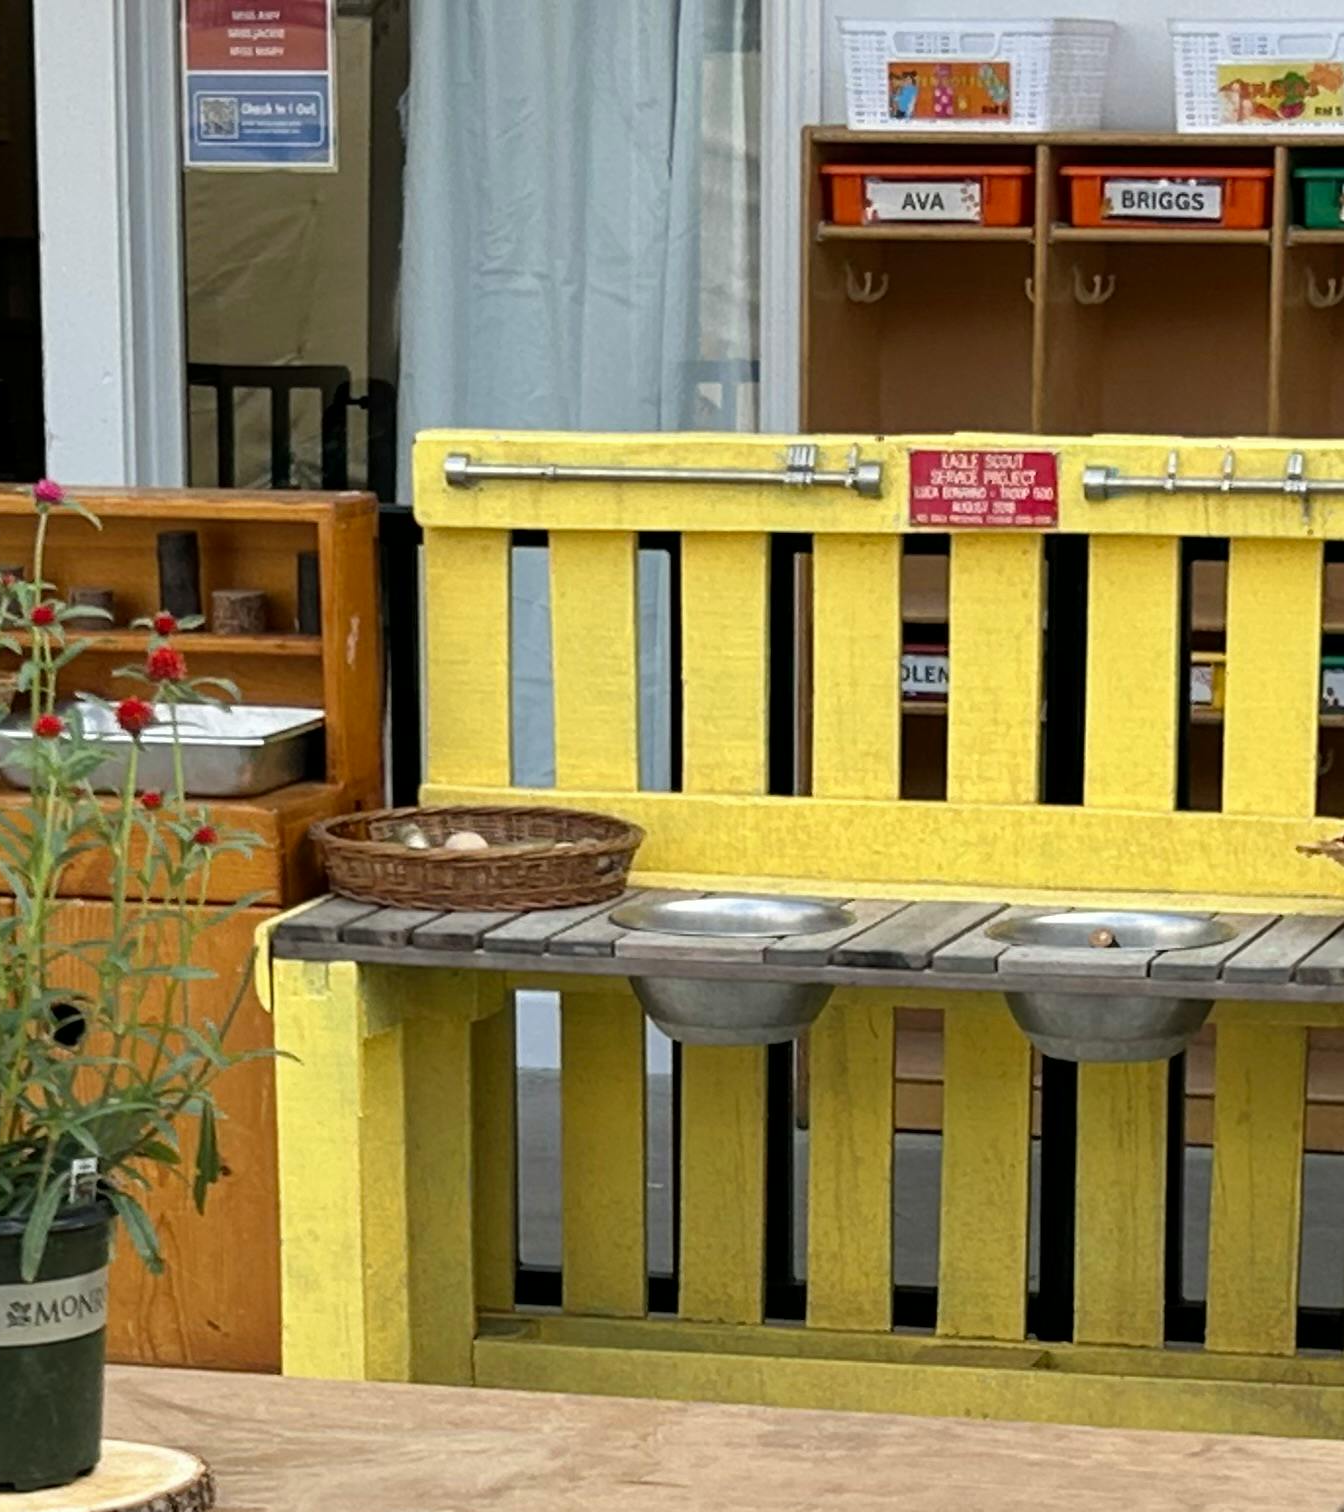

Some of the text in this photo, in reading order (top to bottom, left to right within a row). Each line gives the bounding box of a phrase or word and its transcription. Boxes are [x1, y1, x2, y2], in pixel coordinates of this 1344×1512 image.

[901, 192, 945, 211] AVA
[1121, 189, 1205, 212] BRIGGS
[984, 453, 1025, 470] SCOUT
[982, 469, 1036, 487] PROJECT
